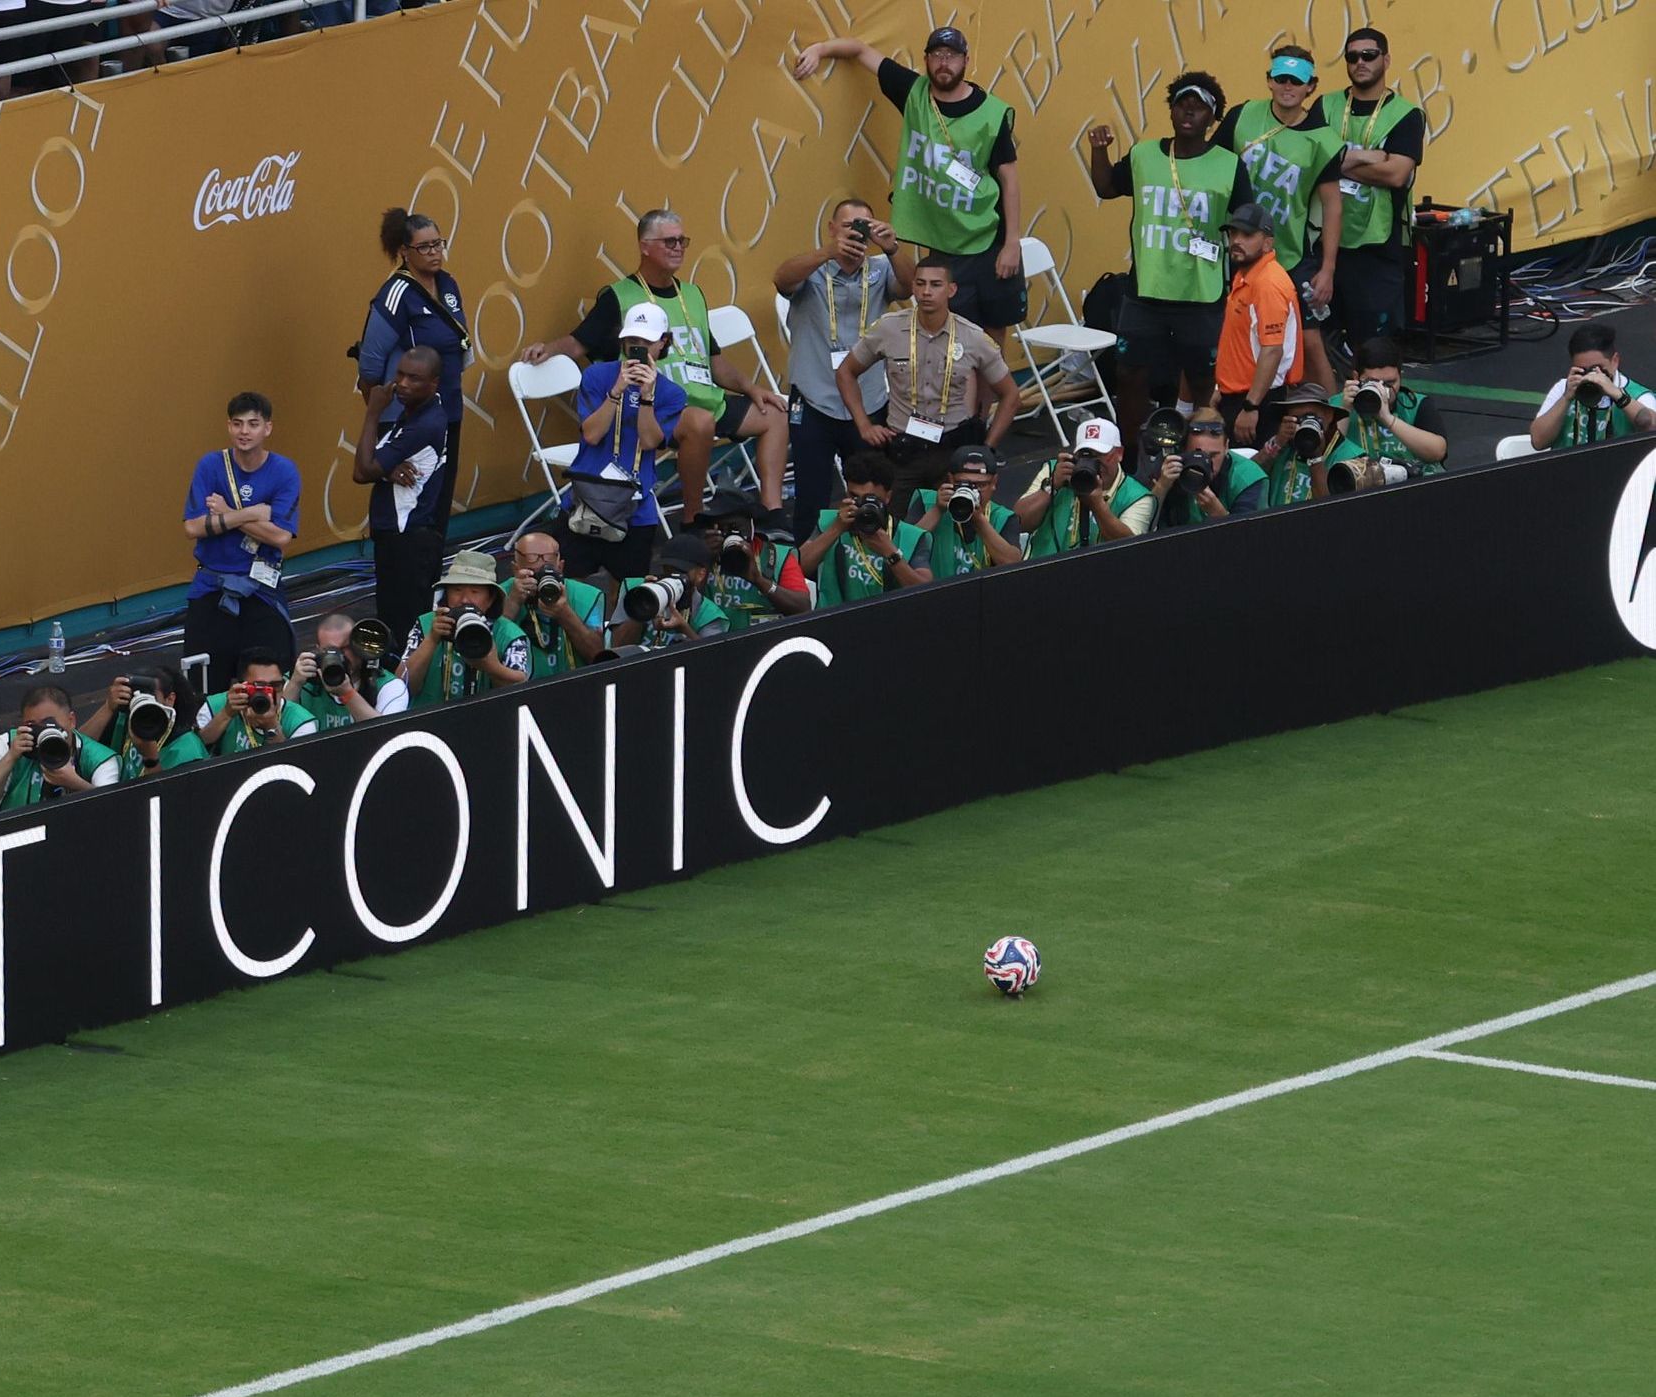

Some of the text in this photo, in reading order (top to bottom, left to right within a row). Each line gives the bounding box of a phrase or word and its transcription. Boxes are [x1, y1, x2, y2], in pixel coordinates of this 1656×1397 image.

[900, 164, 976, 212] PITCH
[1141, 184, 1209, 224] FIFA
[148, 636, 834, 1007] ICONIC
